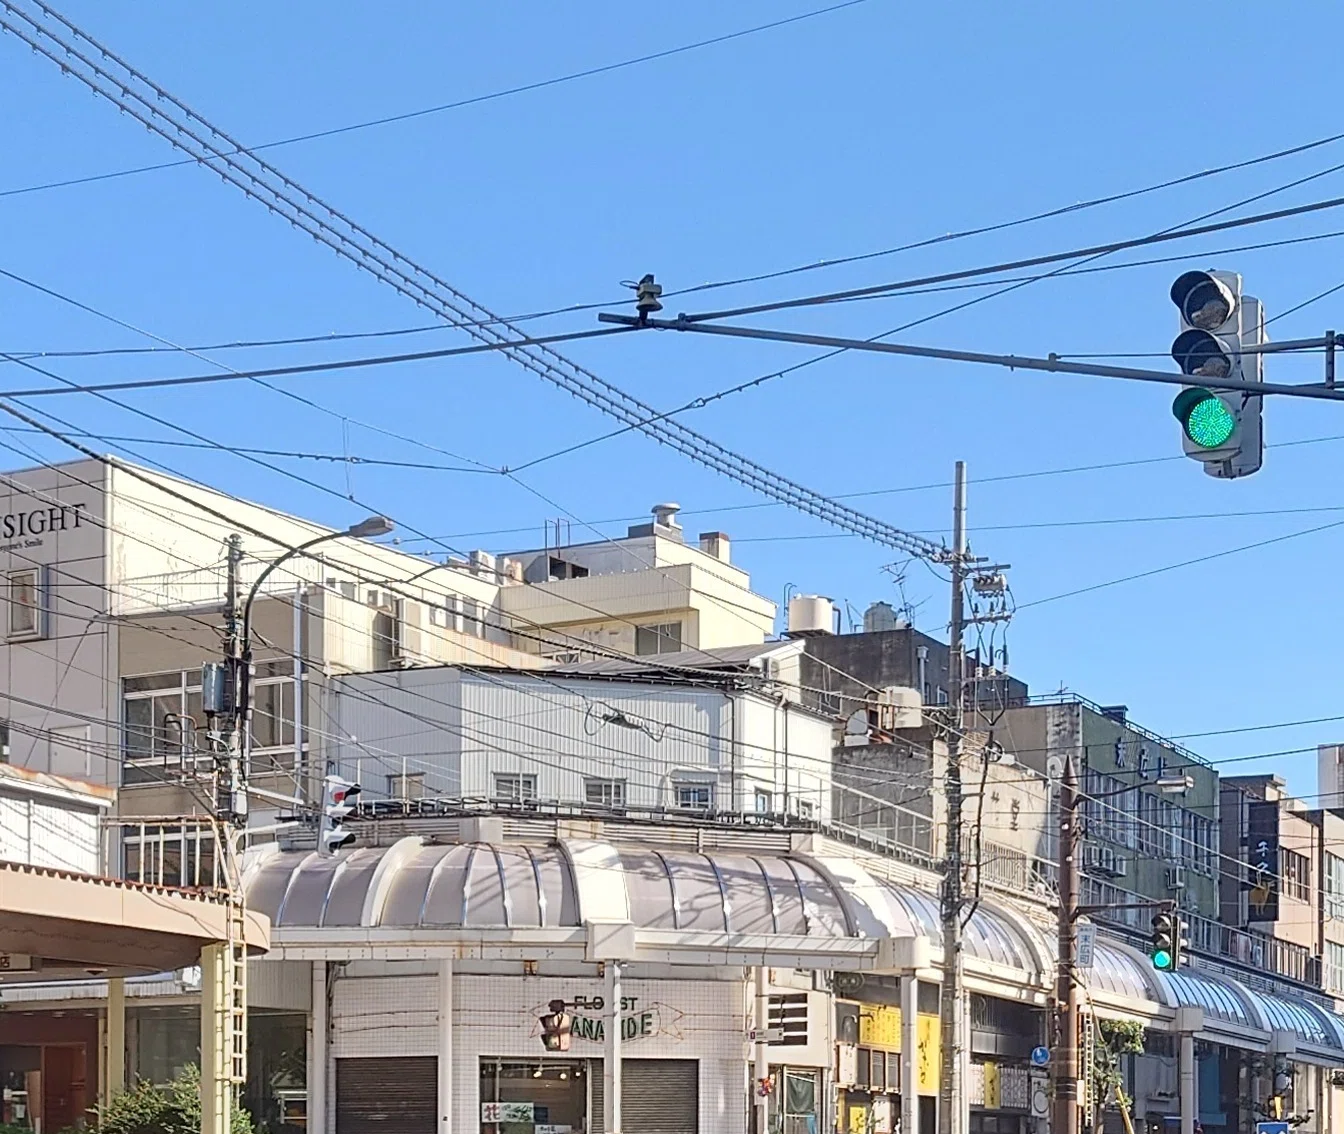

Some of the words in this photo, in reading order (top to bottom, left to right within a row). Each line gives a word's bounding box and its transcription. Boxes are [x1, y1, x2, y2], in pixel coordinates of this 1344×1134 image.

[1080, 934, 1091, 965] 末広町
[574, 996, 638, 1011] FLOST
